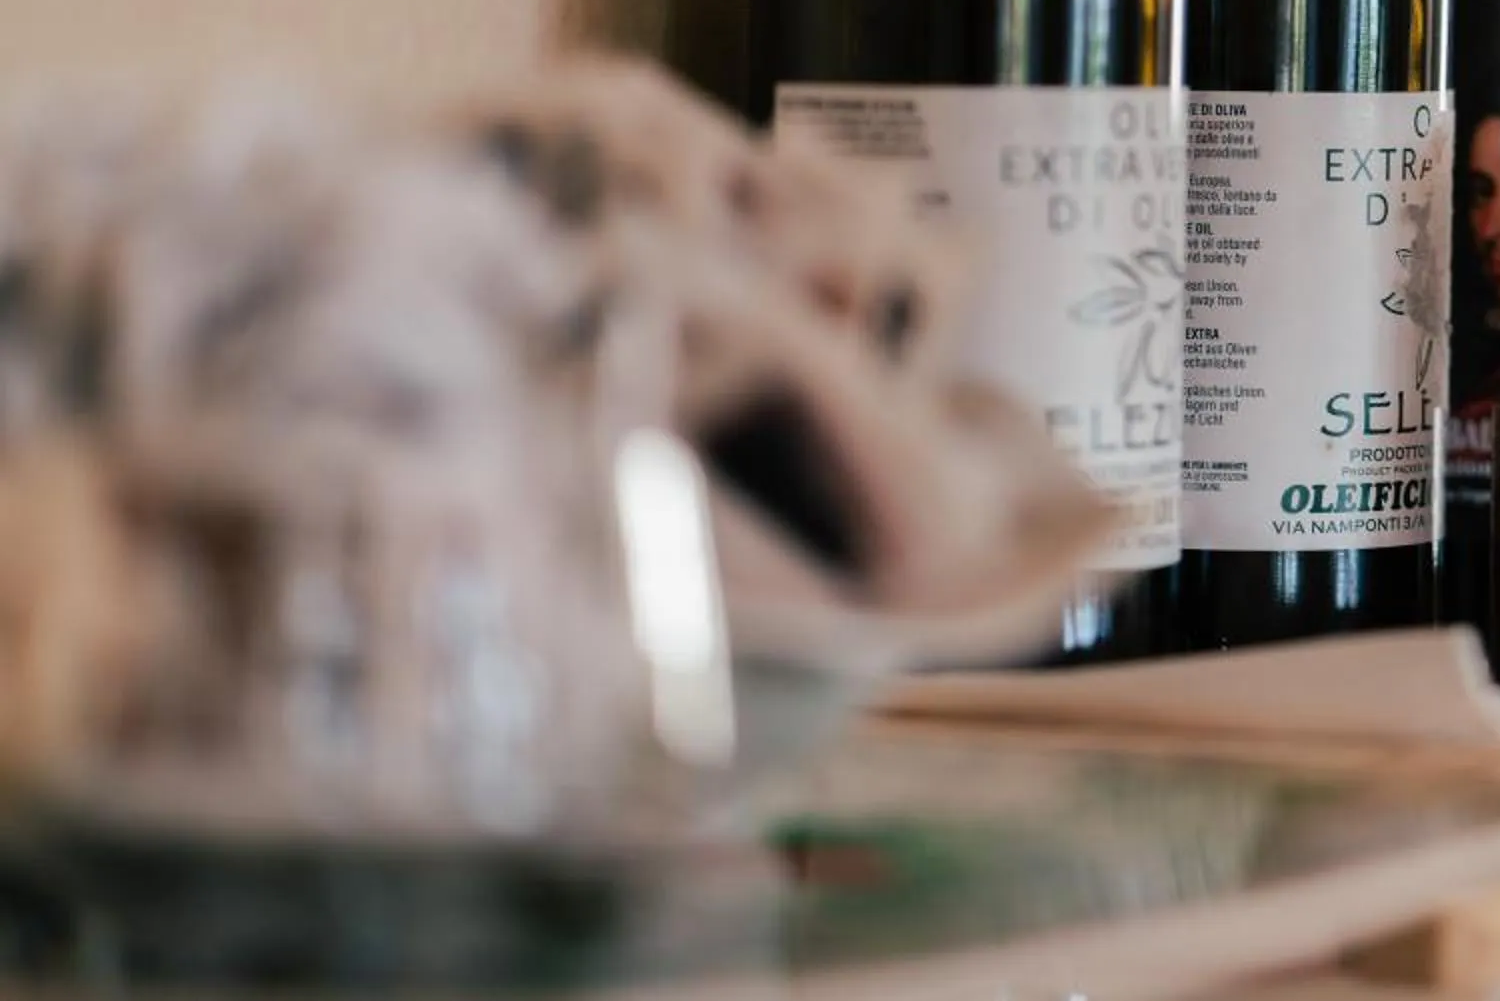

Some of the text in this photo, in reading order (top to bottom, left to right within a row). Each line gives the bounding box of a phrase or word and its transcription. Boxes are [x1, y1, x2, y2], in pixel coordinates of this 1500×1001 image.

[1202, 103, 1213, 116] DI
[1215, 103, 1247, 116] OLIVA
[1195, 222, 1213, 235] OIL
[1201, 238, 1214, 249] oil
[1216, 238, 1261, 250] obtained
[1234, 252, 1248, 267] by
[1217, 294, 1243, 306] from
[1185, 327, 1219, 340] EXTRA
[1349, 445, 1426, 463] PRODOTTO
[1280, 478, 1432, 514] OLEIFICI
[1272, 520, 1307, 536] VIA
[1311, 518, 1402, 535] NAMPONTI
